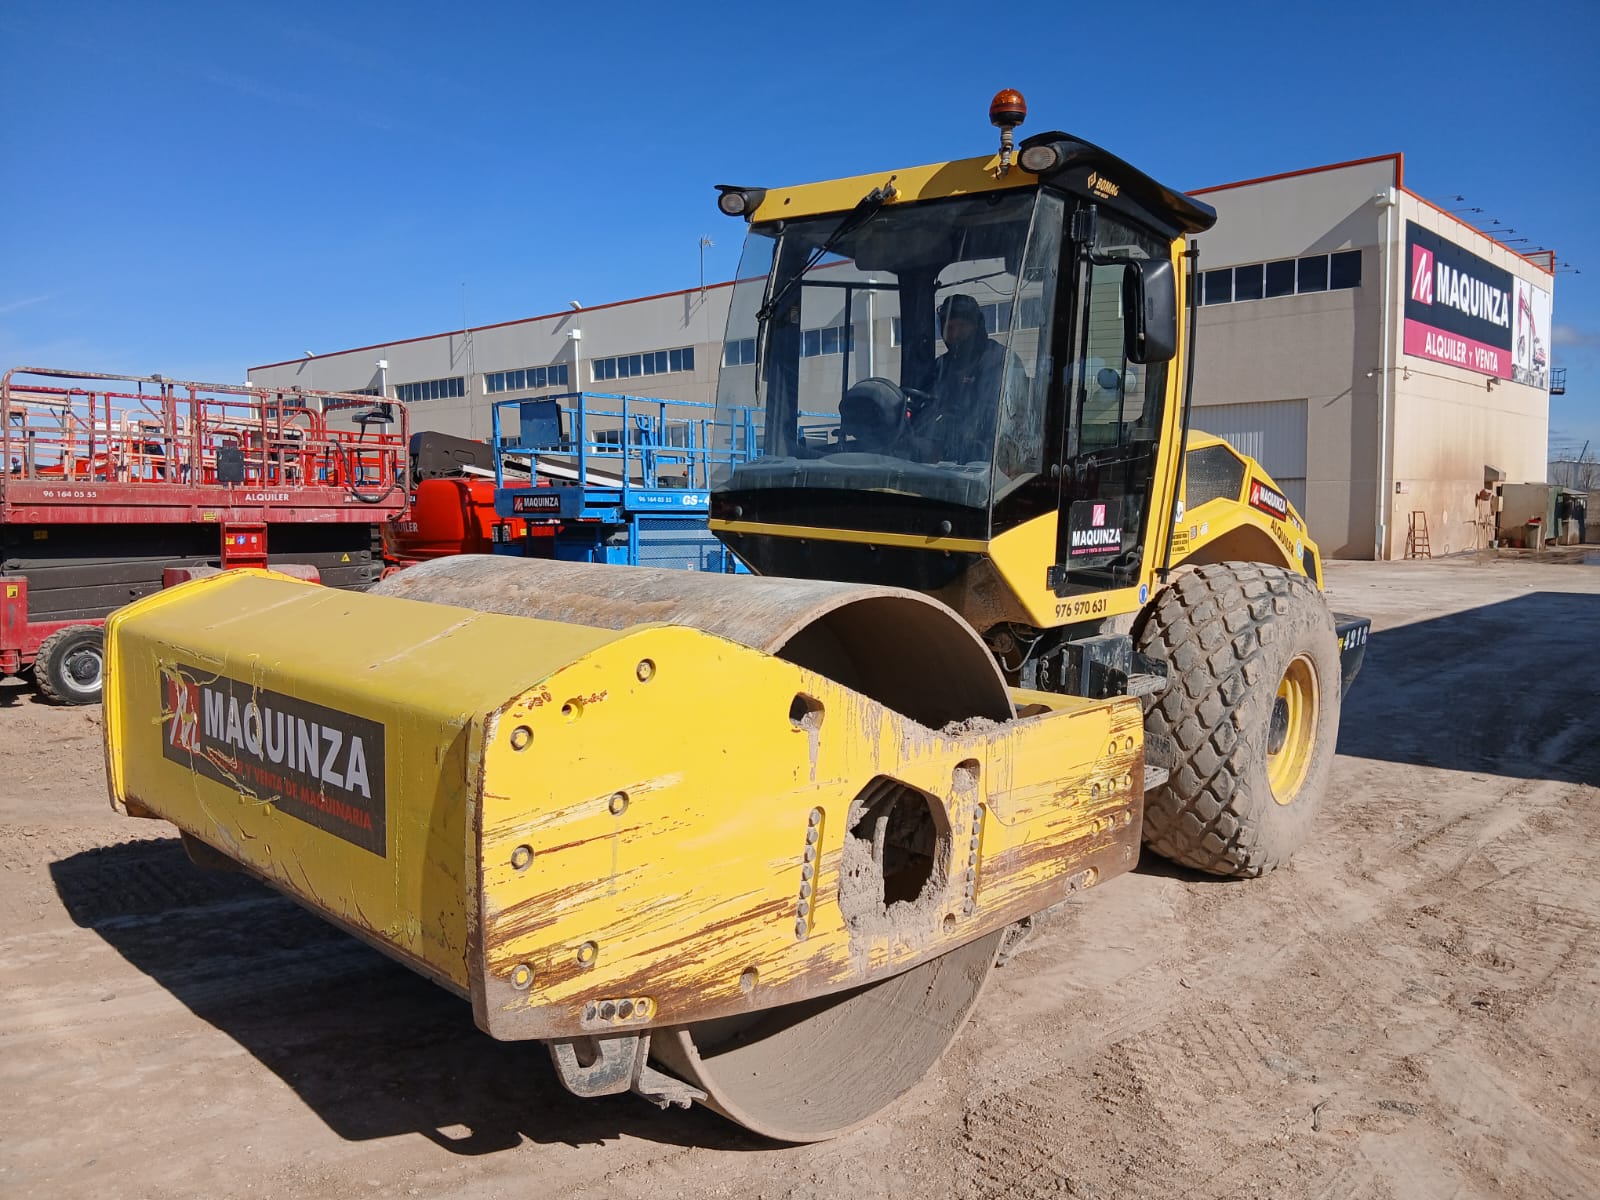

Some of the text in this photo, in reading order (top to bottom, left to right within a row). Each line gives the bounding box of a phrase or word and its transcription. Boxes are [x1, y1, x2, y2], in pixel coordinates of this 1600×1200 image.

[1095, 177, 1119, 197] BOMAG
[1437, 262, 1509, 328] MAQUINZA
[1425, 332, 1466, 363] ALQUILER
[1475, 347, 1498, 372] VENTA
[43, 490, 54, 498] 96
[57, 490, 72, 498] 164
[245, 493, 289, 501] ALQUILER
[524, 497, 559, 507] MAQUINZA
[1260, 486, 1286, 514] MAQUINZA
[1072, 529, 1121, 547] MAQUINZA
[1270, 519, 1294, 557] ALQUILER
[1055, 598, 1107, 618] 976 970 631
[204, 687, 371, 799] MAQUINZA
[254, 768, 282, 793] VENTA
[285, 778, 298, 799] DE
[301, 787, 373, 831] MAQUINARIA
